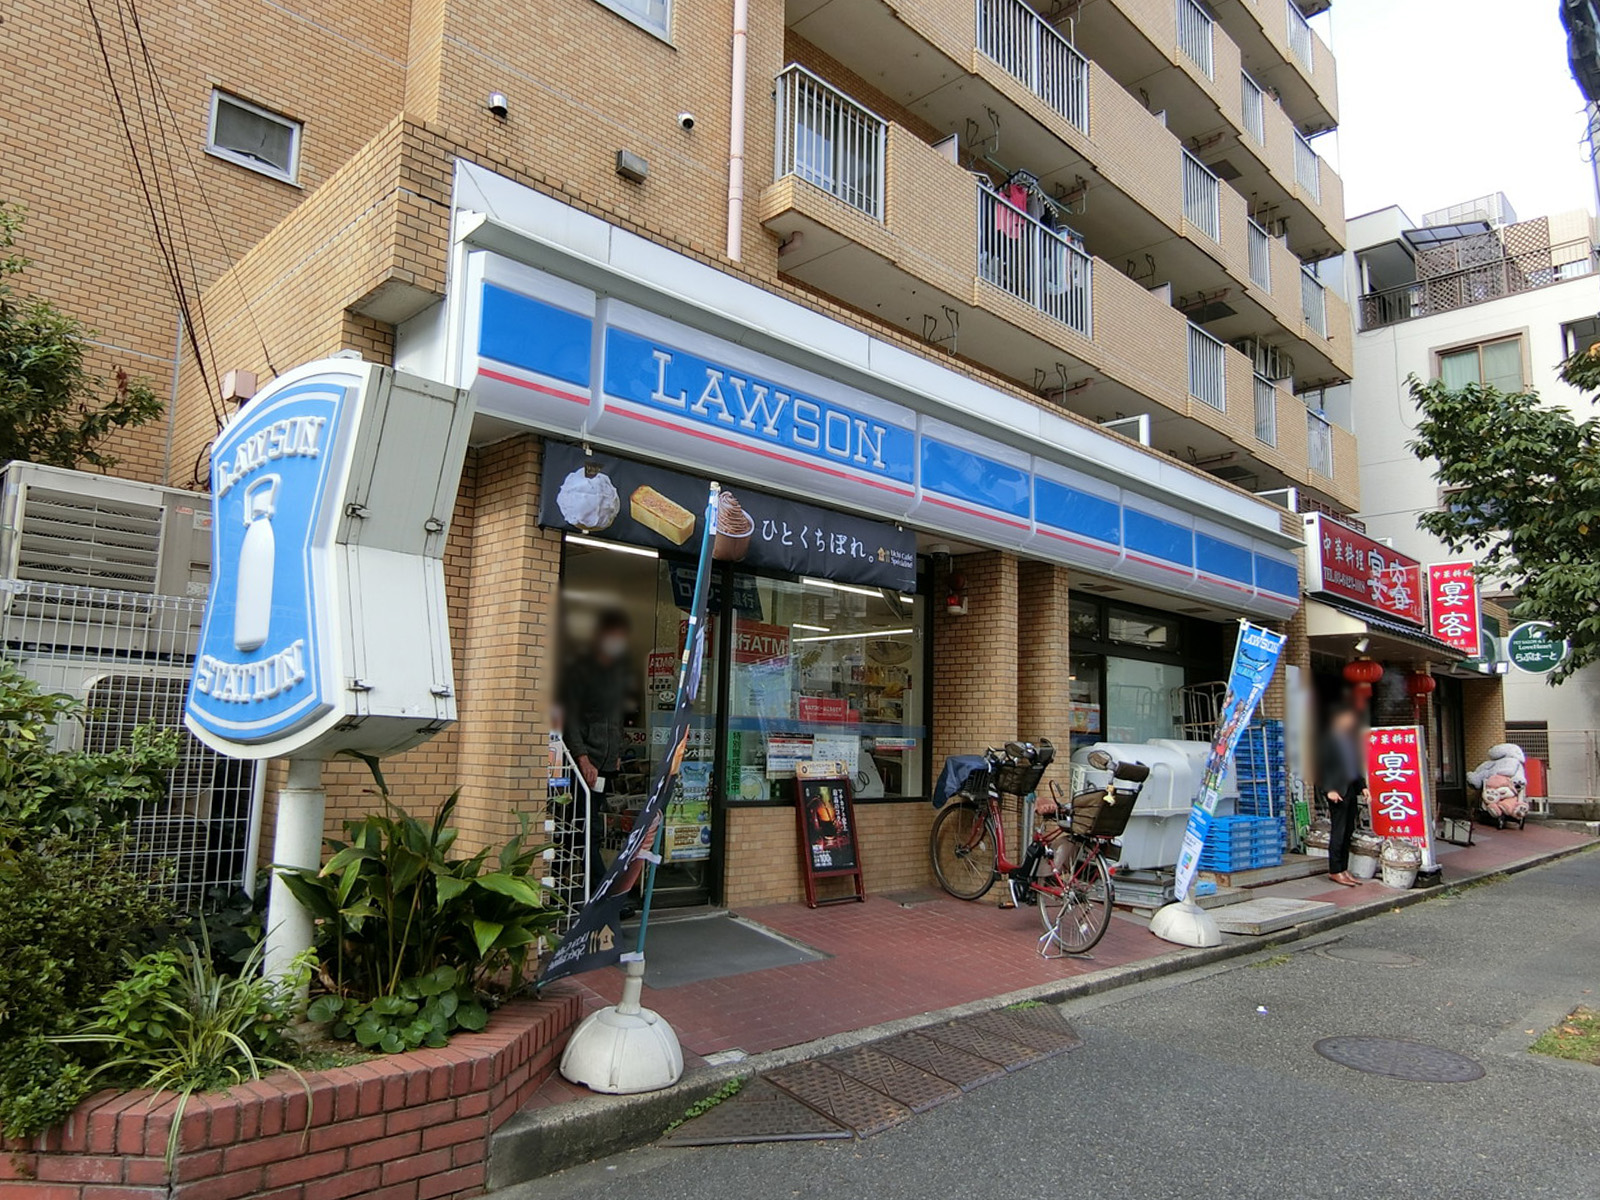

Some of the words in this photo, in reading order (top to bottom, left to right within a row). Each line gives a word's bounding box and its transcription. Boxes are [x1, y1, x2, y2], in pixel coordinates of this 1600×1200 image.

[652, 350, 886, 469] LAWSON
[218, 416, 327, 499] LAWSON
[762, 519, 874, 563] ひとくちぼれ。
[1367, 549, 1414, 610] 宴客
[1437, 581, 1471, 637] 宴客
[197, 639, 306, 704] STATION
[1242, 632, 1280, 655] LAWSON
[1515, 652, 1557, 662] らぶはーと
[1375, 751, 1418, 820] 宴客
